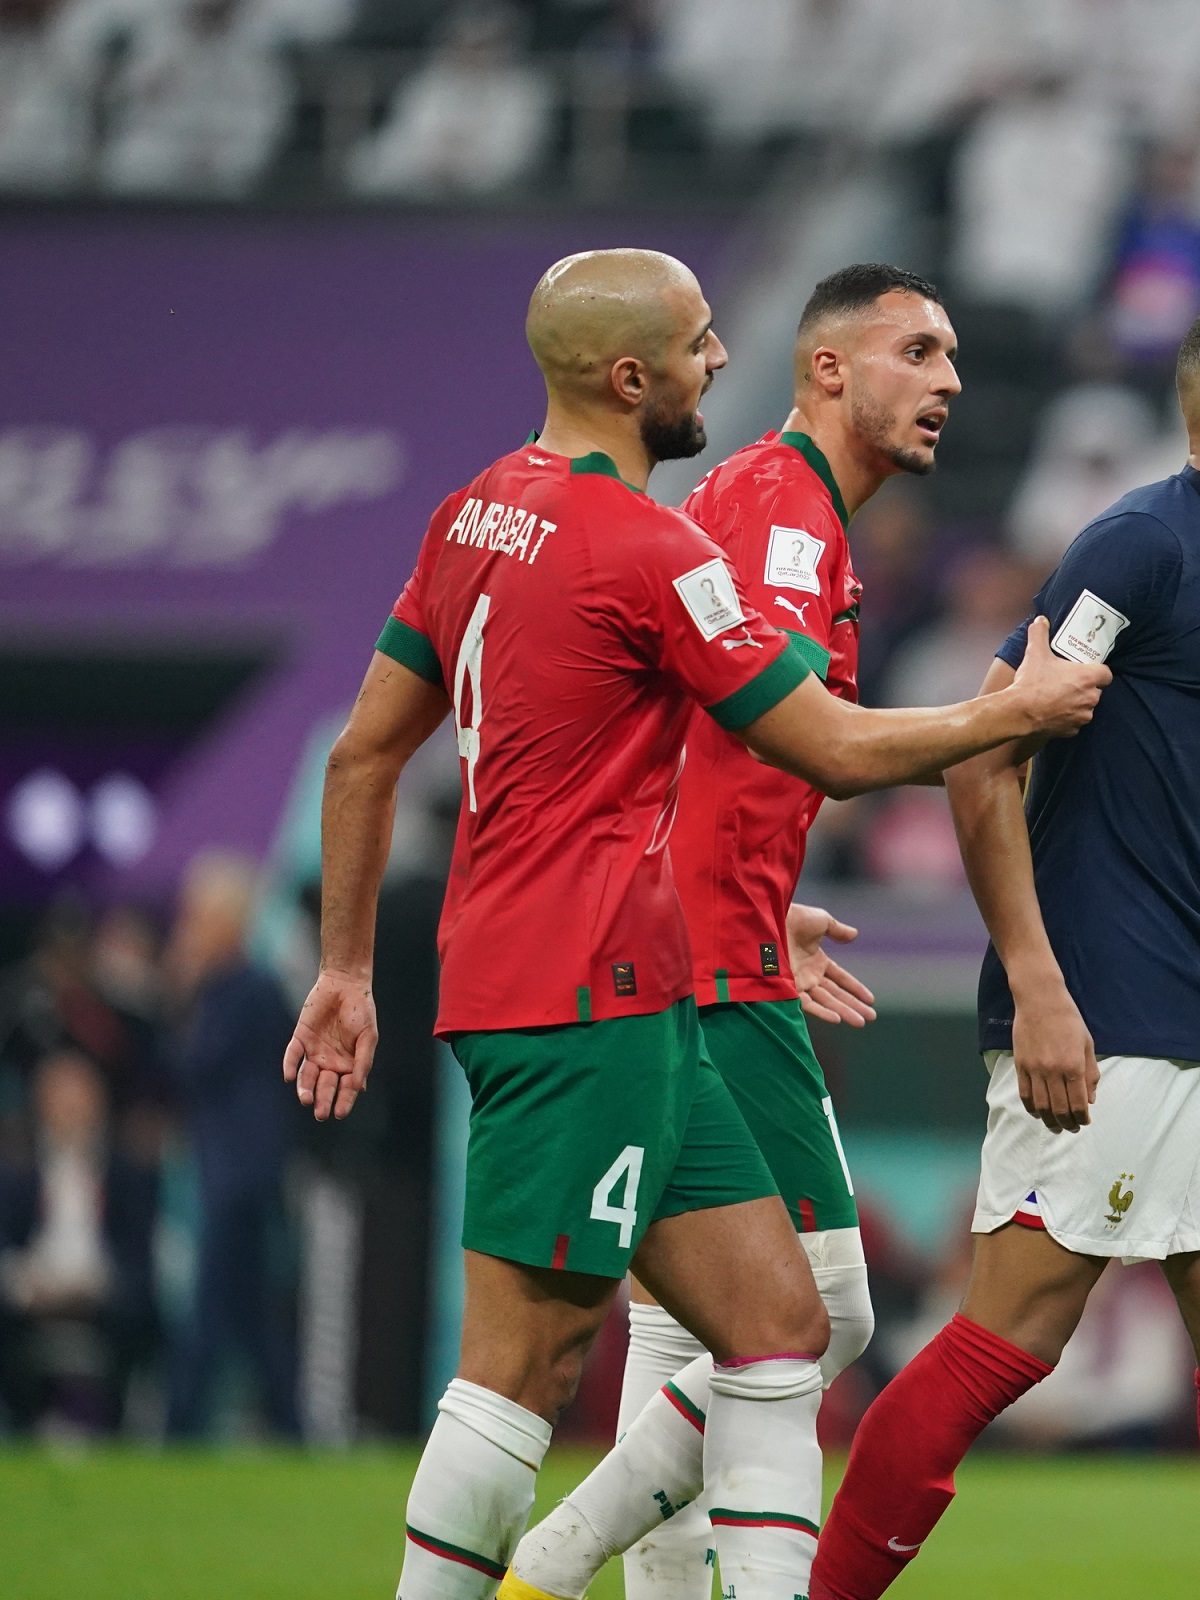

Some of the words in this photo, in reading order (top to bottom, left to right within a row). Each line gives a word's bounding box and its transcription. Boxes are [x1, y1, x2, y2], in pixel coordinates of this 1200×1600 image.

[446, 498, 557, 565] AMRABAT
[454, 593, 491, 813] 4
[589, 1144, 645, 1249] 4
